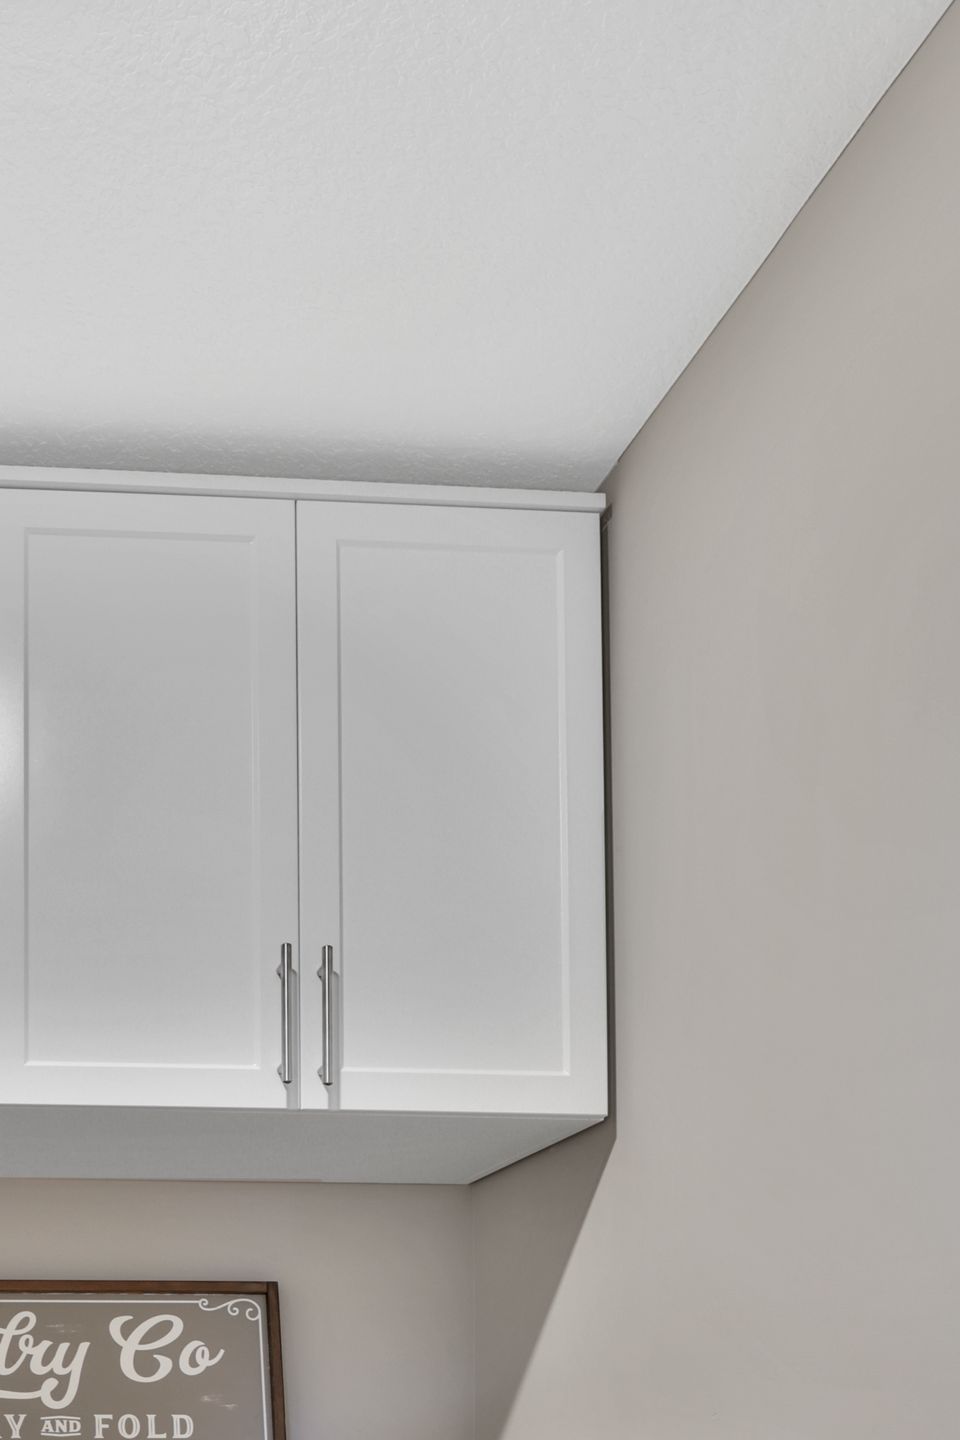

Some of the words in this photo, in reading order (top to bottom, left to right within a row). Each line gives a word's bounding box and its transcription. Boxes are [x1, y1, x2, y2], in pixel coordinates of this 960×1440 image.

[109, 1314, 224, 1383] Co
[41, 1417, 81, 1436] AND
[94, 1414, 195, 1439] FOLD
